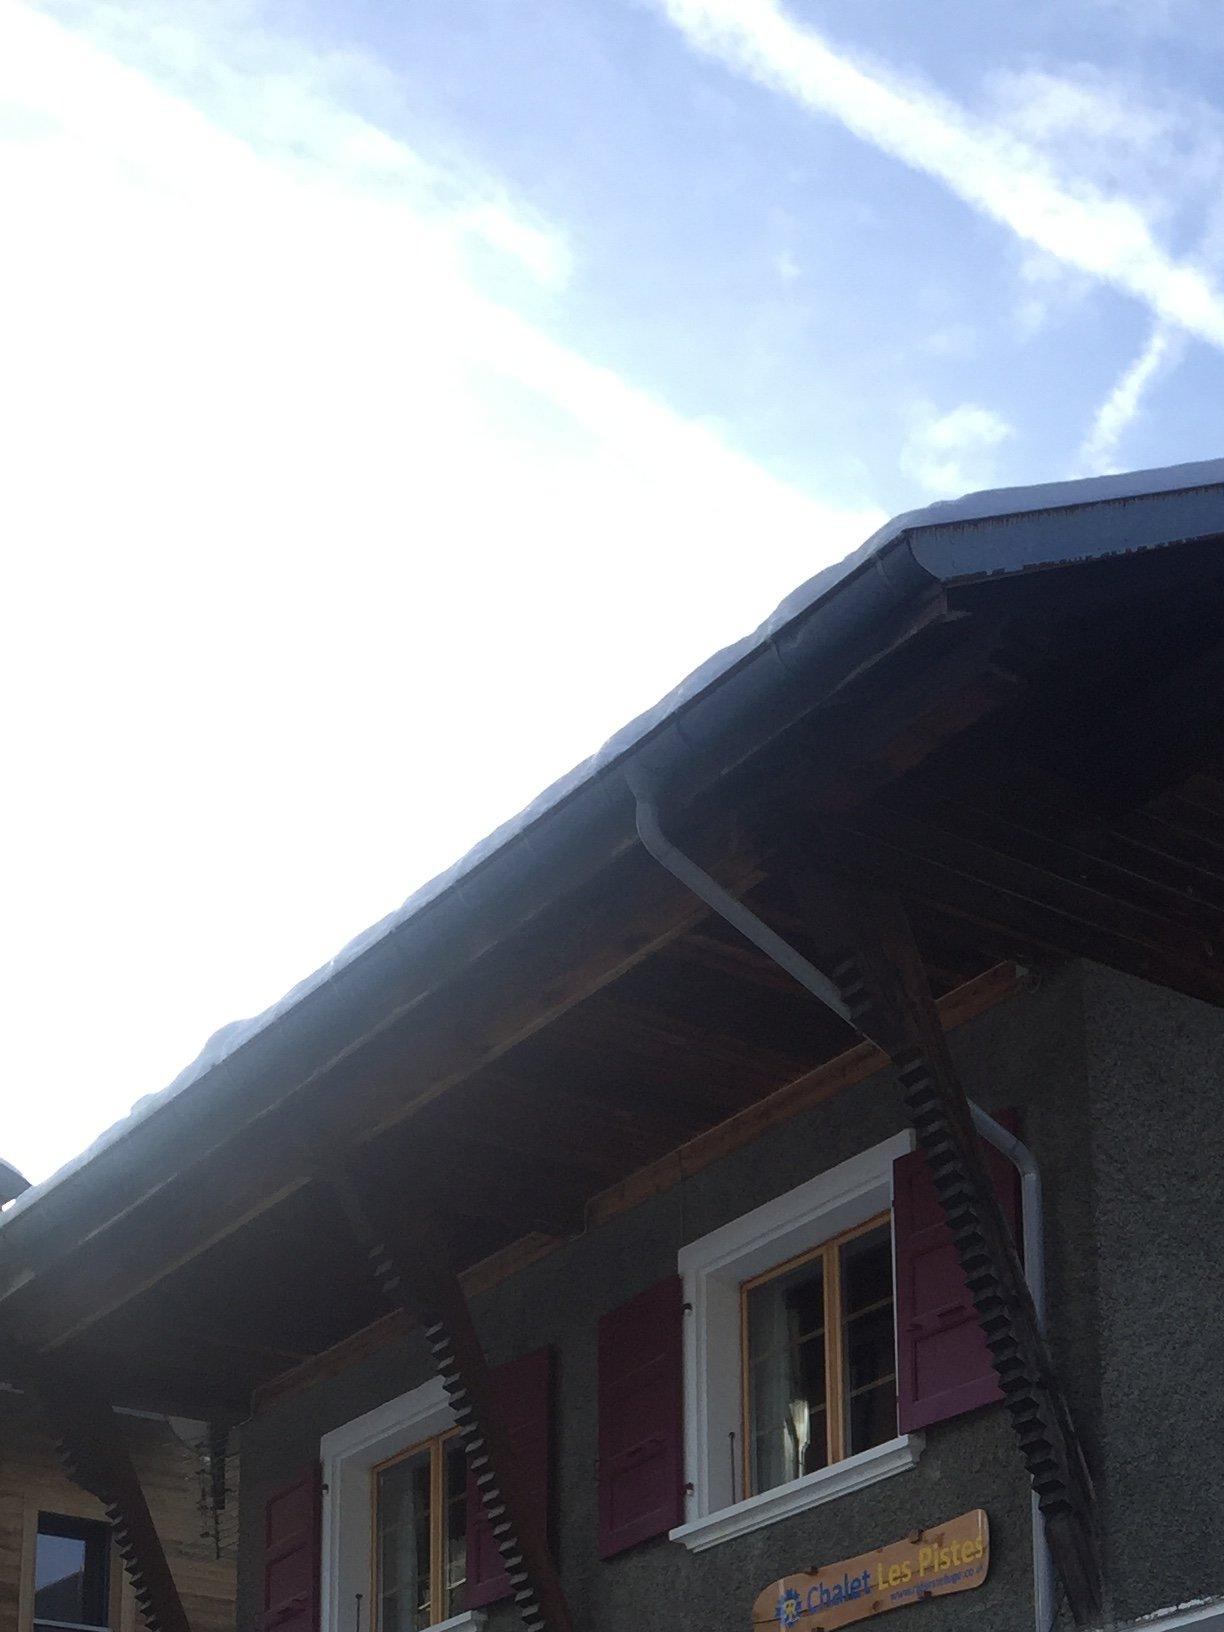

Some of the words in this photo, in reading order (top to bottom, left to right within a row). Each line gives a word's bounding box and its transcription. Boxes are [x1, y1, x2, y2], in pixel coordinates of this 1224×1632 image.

[807, 1569, 871, 1615] Chalet
[877, 1562, 912, 1591] Les
[918, 1535, 986, 1577] Pistes
